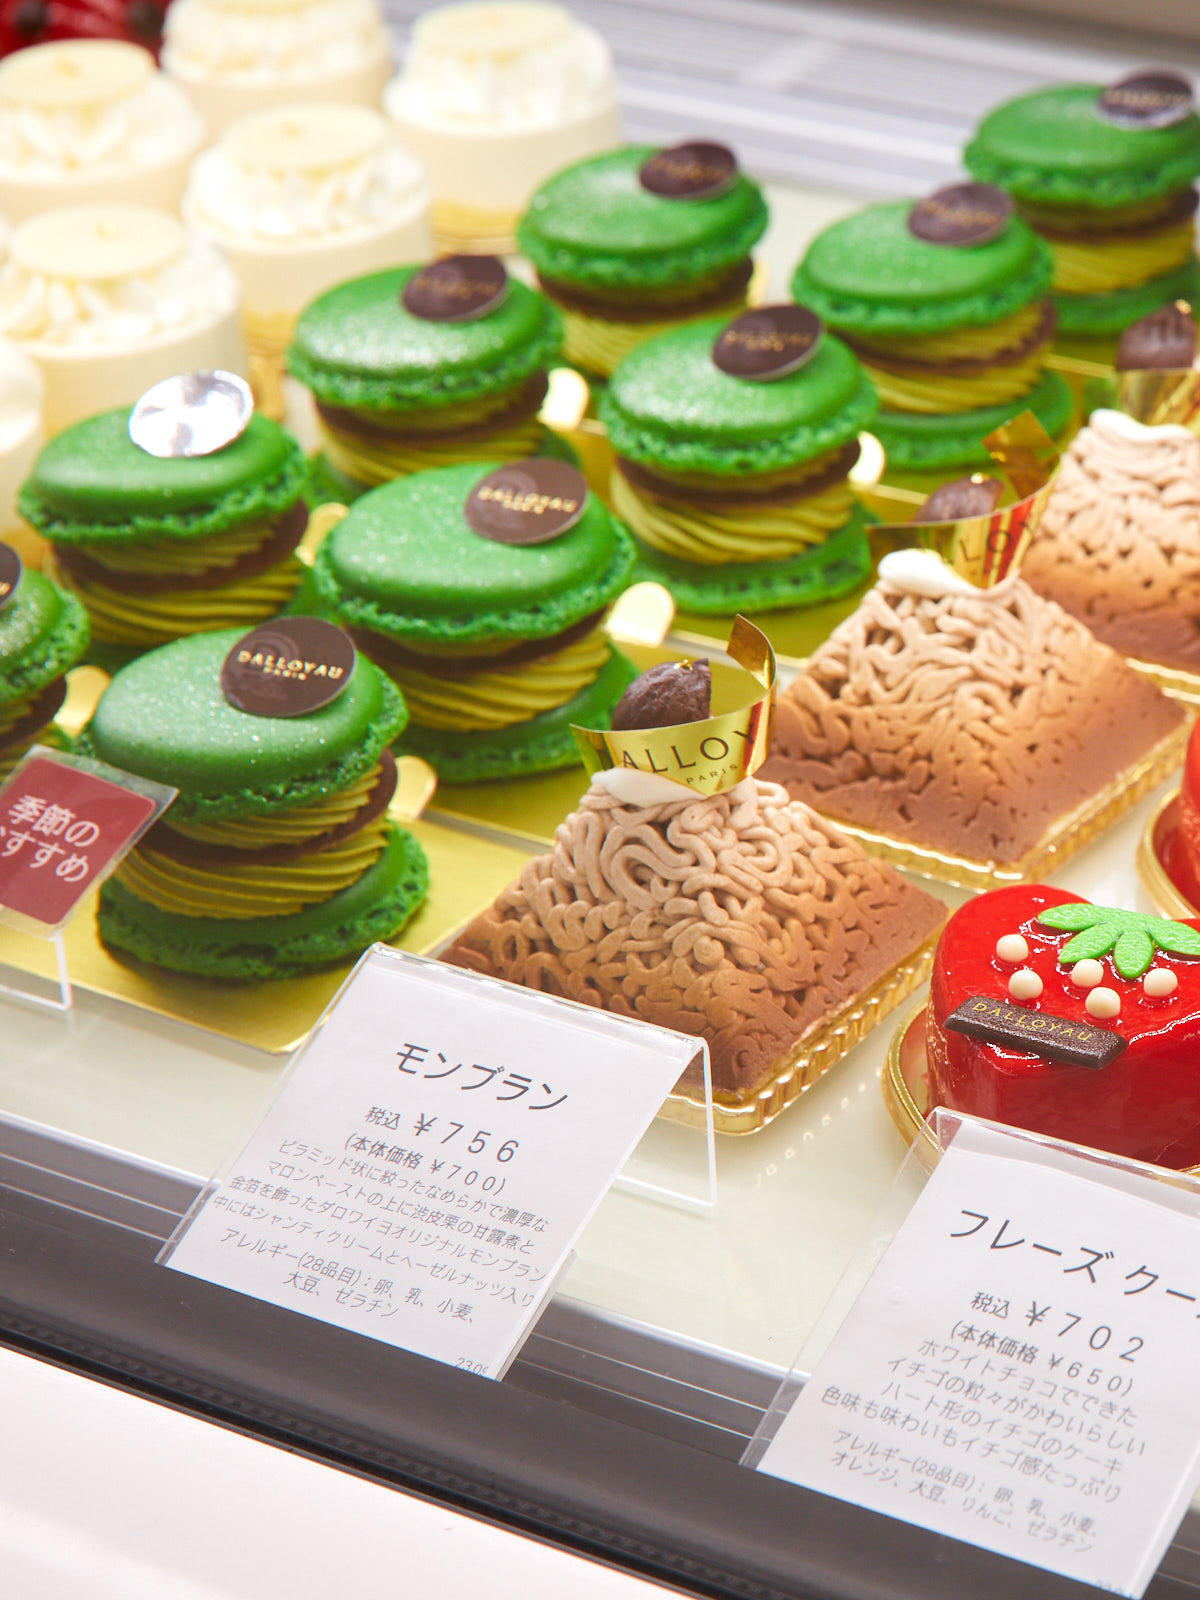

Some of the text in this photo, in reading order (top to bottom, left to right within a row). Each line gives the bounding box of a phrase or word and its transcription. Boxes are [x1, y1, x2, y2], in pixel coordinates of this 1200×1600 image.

[237, 650, 343, 679] DALLOYAU
[600, 724, 754, 773] ALLOY
[686, 763, 739, 785] PARIS
[0, 826, 88, 882] すすめ
[8, 795, 100, 848] 季節の
[972, 1002, 1093, 1041] DALLOYAU
[395, 1042, 569, 1111] モンブラン
[365, 1106, 519, 1163] 税込 ¥756
[267, 1160, 535, 1254] マロンペーストの上に渋皮栗の甘露煮と
[278, 1140, 549, 1233] ピラミッド状に絞ったなめらかで濃厚な
[950, 1209, 1115, 1283] フレーズ
[970, 1291, 1144, 1362] 税込 ¥702
[887, 1357, 1146, 1456] イチゴの粒々がかわいらしい
[918, 1339, 1138, 1427] ホワイトチョコでできた
[821, 1385, 1122, 1503] 色味も味わいもイチゴ感たっぷり
[882, 1381, 1123, 1476] ハート形のイチゴのケーキ
